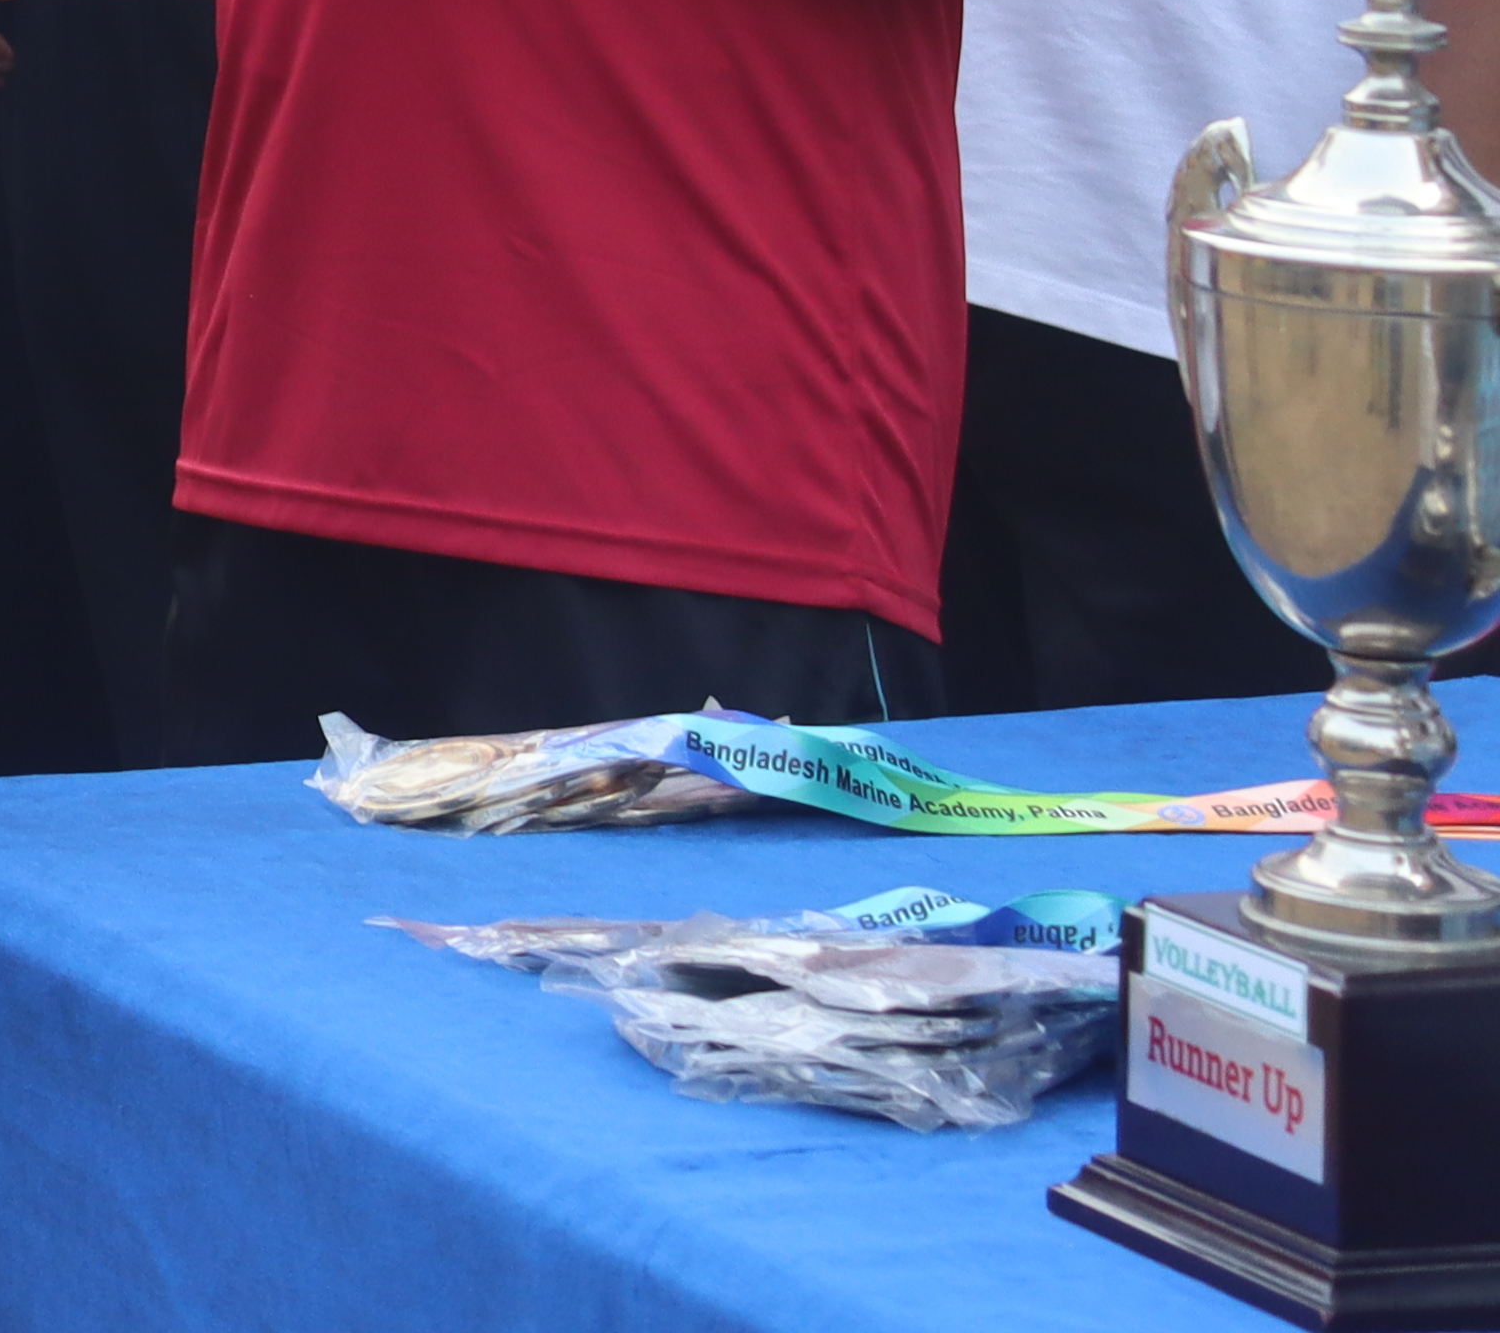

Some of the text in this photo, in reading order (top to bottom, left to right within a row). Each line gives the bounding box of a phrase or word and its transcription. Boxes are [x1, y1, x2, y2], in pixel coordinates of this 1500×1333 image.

[686, 731, 829, 785] Bangladesh
[836, 766, 902, 809] Marine
[909, 793, 1025, 822] Academy,
[1028, 804, 1108, 820] Pabna
[1014, 924, 1097, 951] Pabna
[1153, 935, 1297, 1018] VOLLEYBALL
[1148, 1016, 1305, 1135] Runner Up
